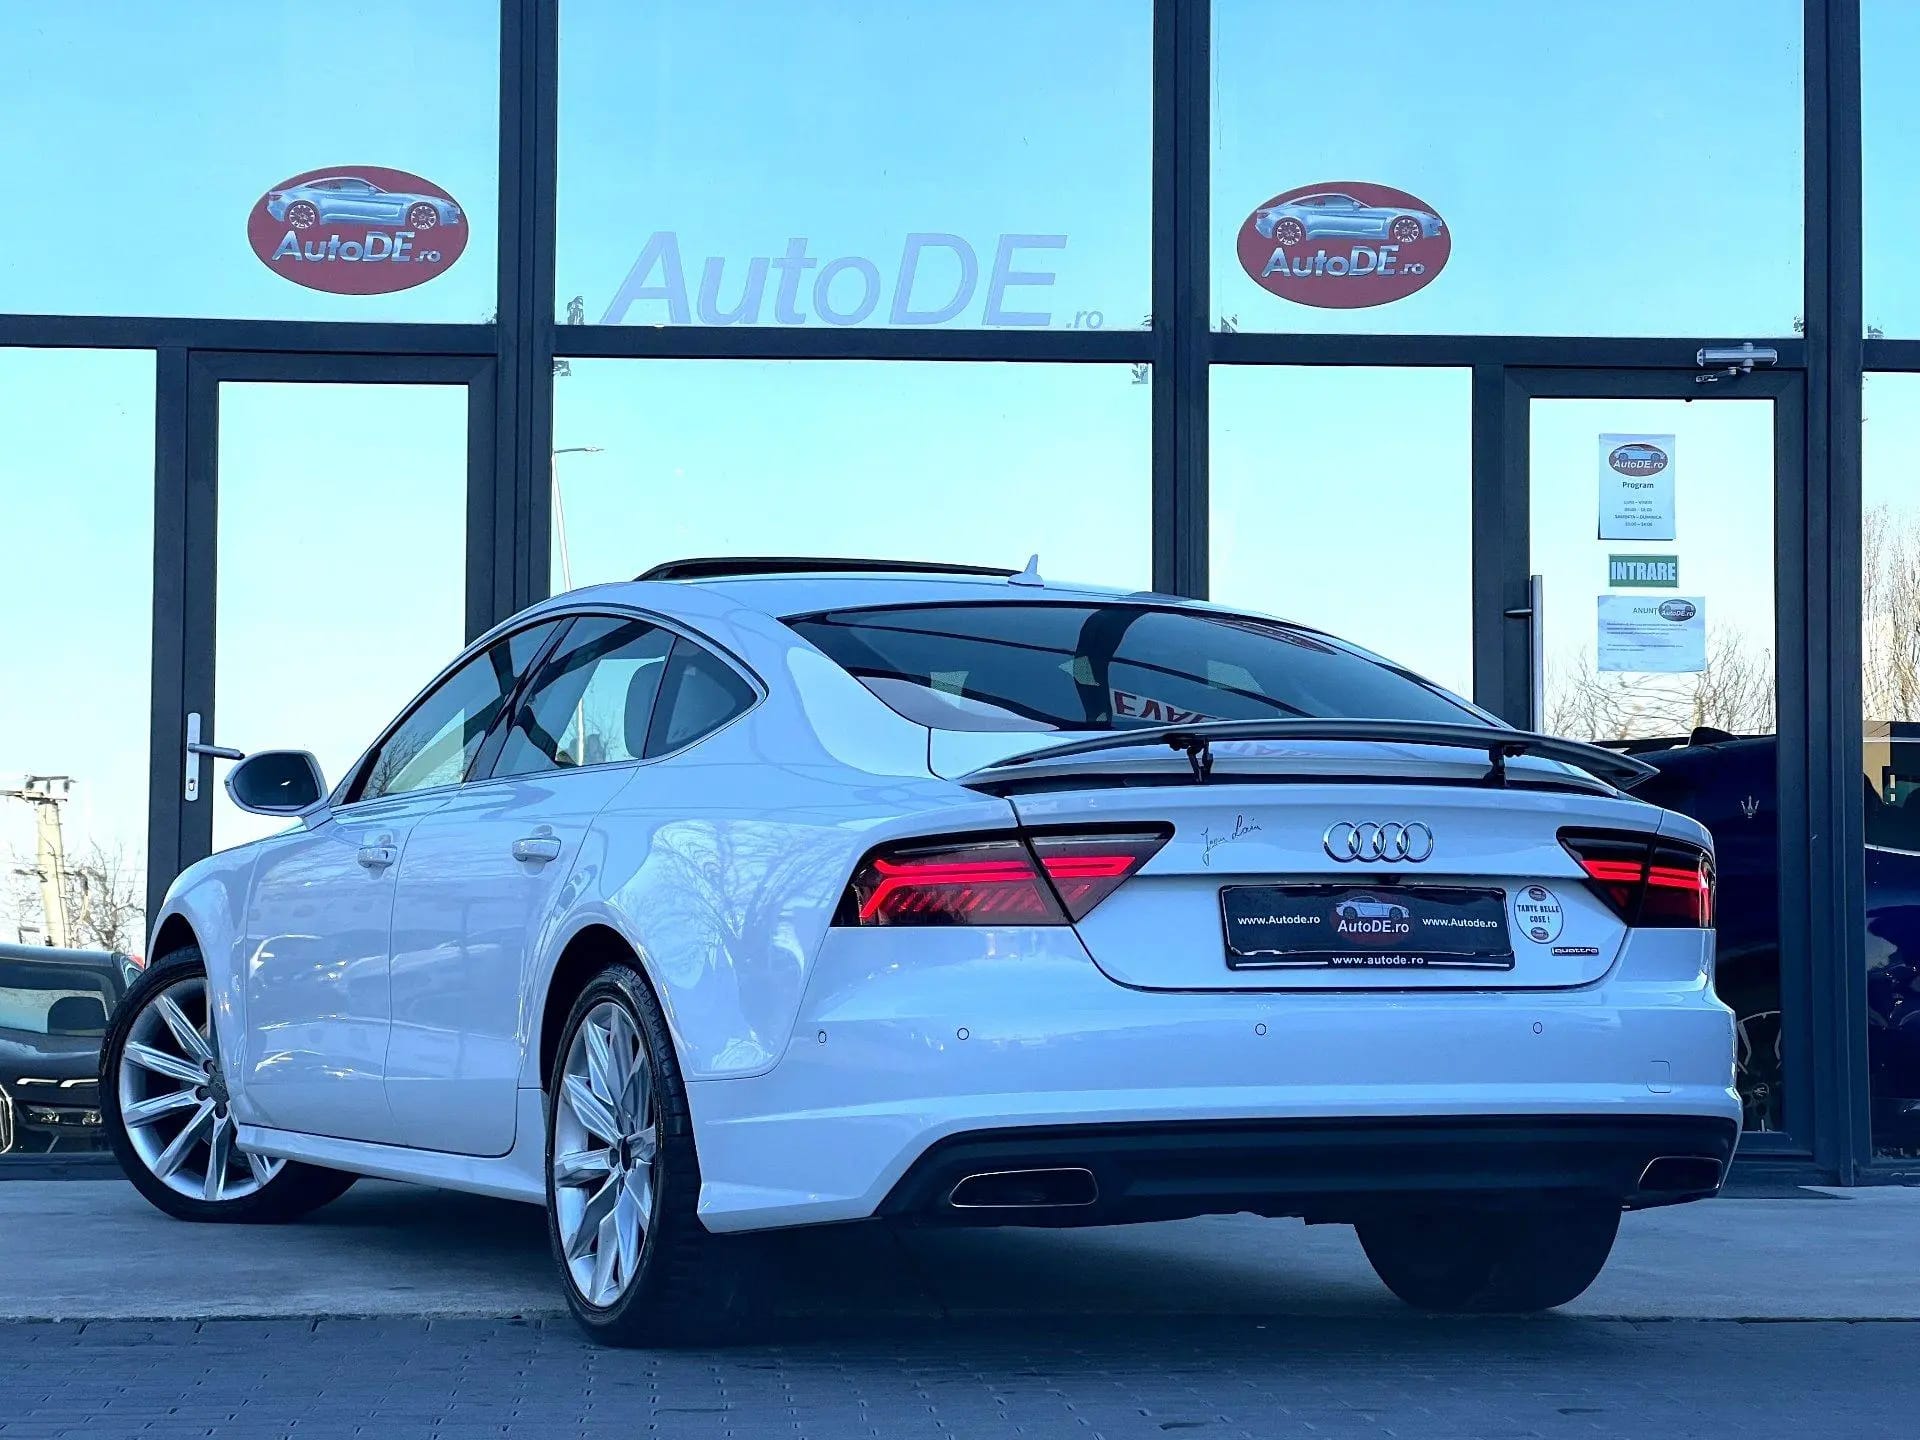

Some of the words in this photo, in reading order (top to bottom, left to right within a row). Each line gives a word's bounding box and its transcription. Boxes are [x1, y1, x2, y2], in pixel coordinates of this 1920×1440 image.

[1613, 460, 1664, 469] AutoDE.ro
[1622, 481, 1654, 490] Program
[1611, 561, 1676, 581] INTRARE
[1540, 904, 1560, 913] BELLE
[1237, 914, 1321, 925] www.Autode.ro
[1422, 917, 1498, 928] www.Autode.ro
[1337, 919, 1410, 933] AutoDE.ro
[1554, 947, 1598, 955] quattro
[1332, 955, 1424, 965] www.autode.ro
